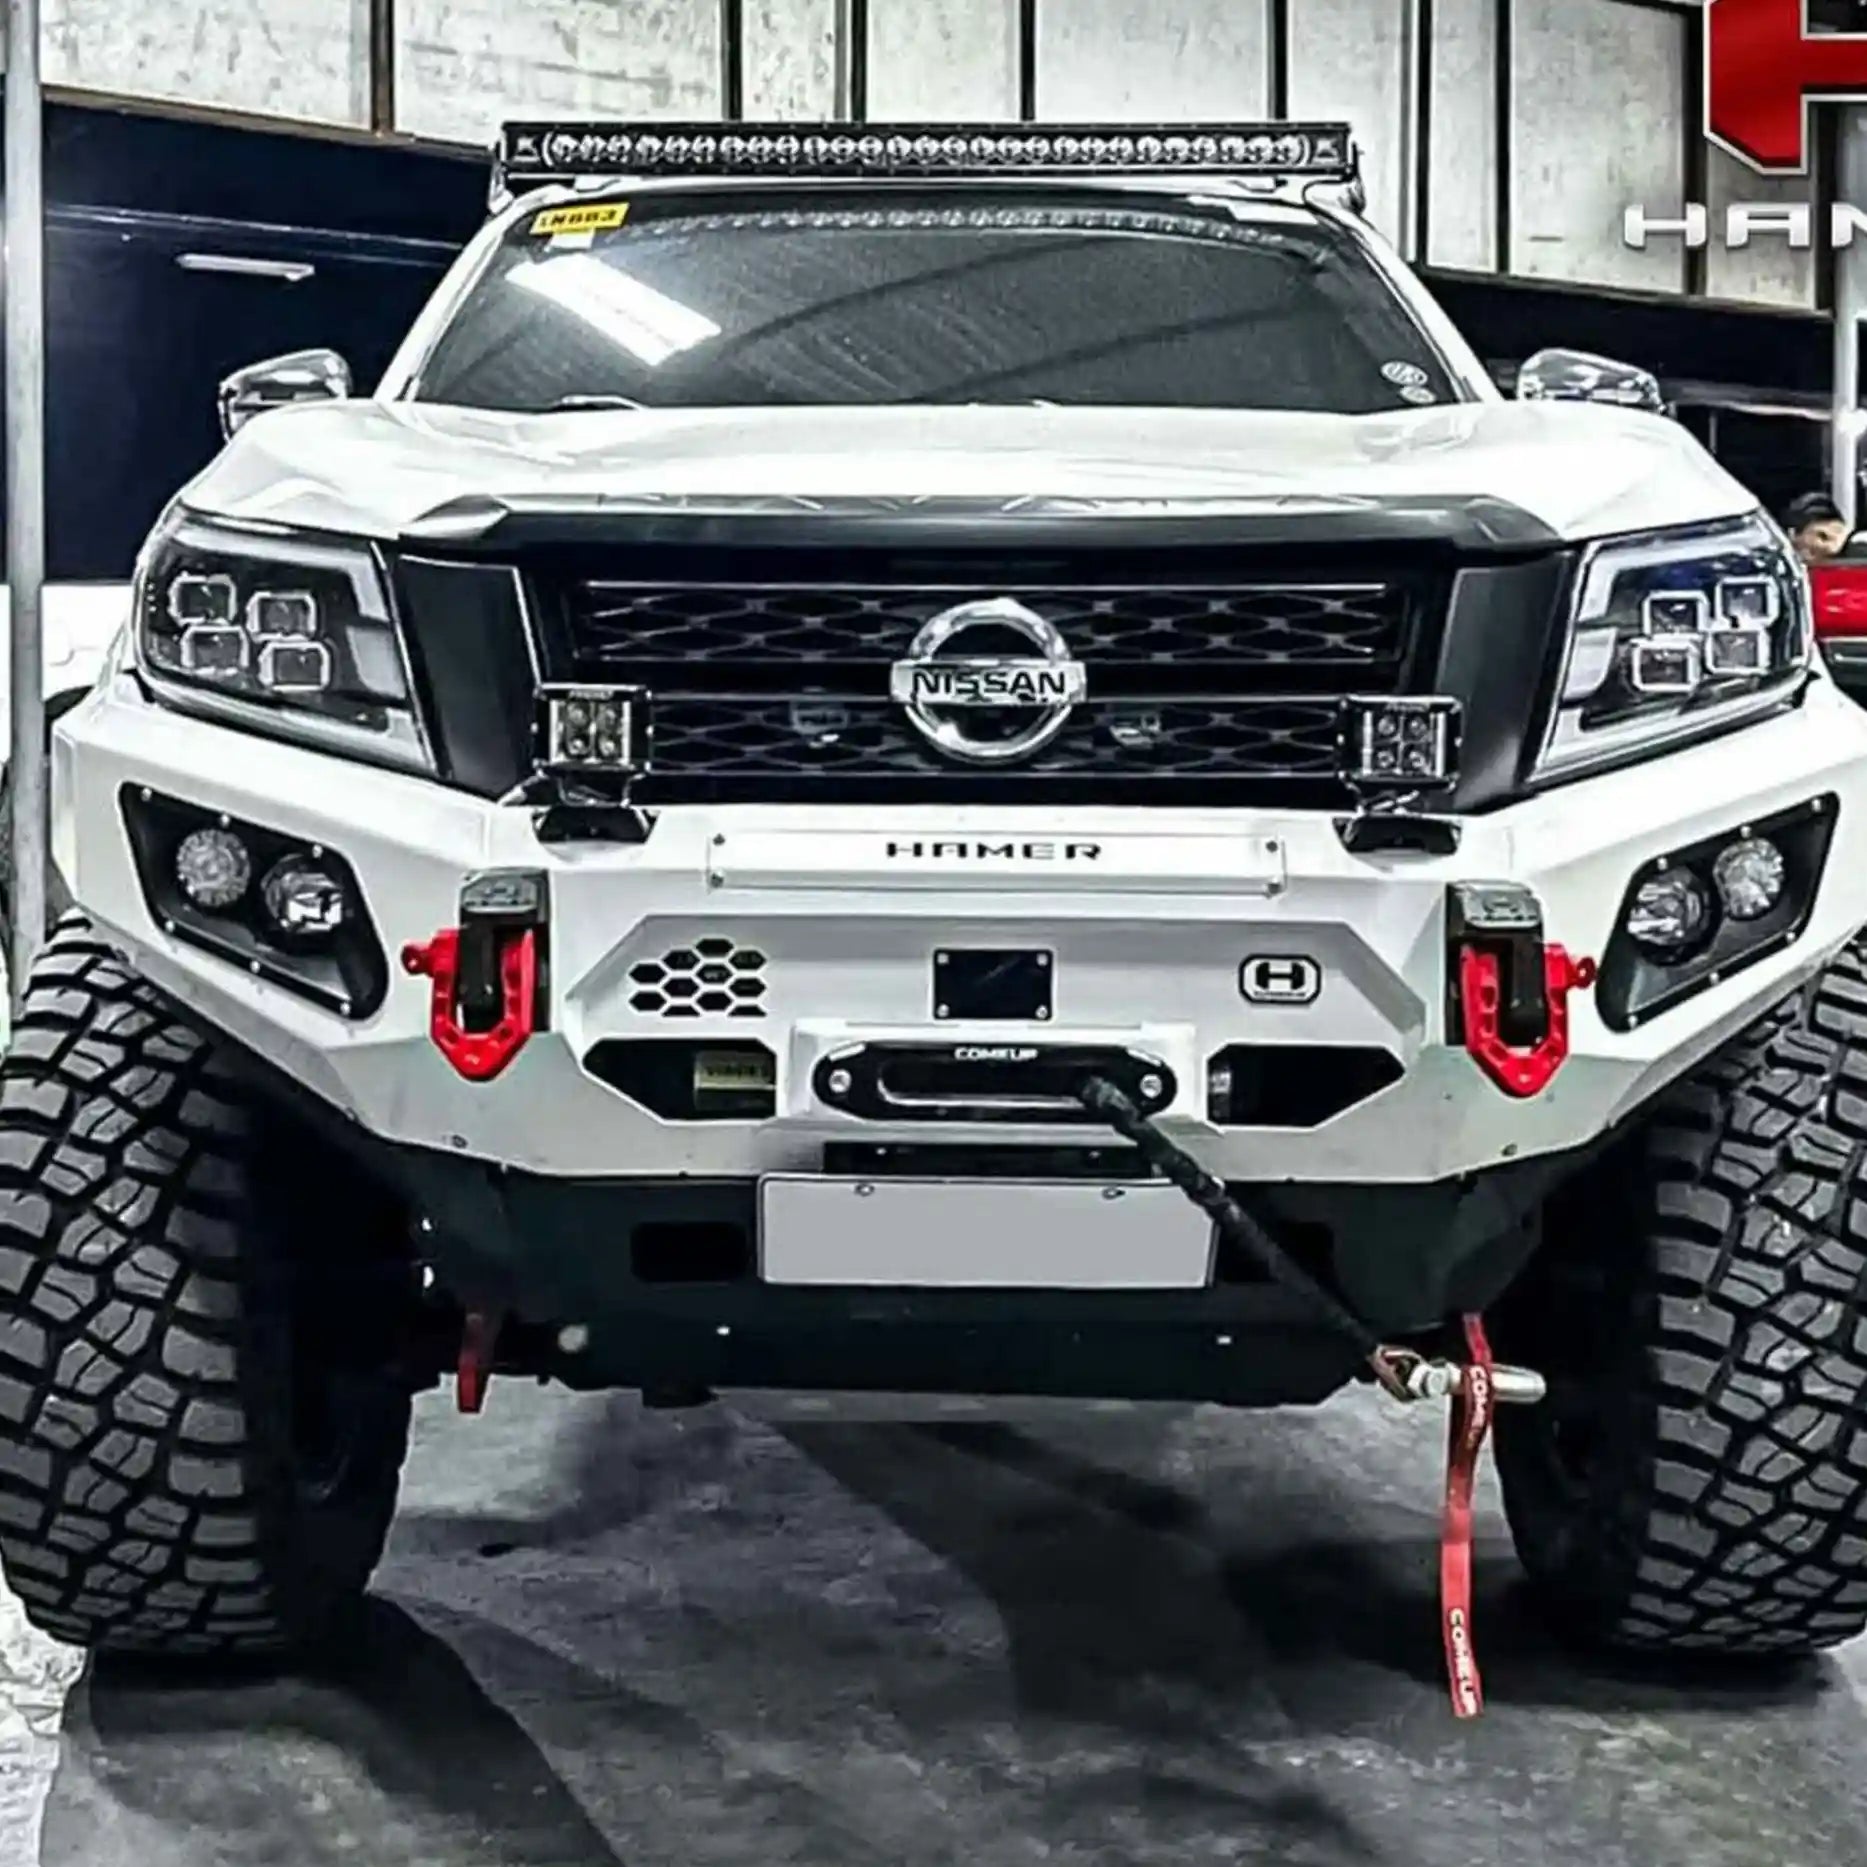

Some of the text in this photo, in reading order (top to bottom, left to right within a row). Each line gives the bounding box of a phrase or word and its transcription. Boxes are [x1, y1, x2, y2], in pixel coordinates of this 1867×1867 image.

[912, 670, 1066, 695] NISSAN
[887, 842, 1101, 860] HAMER
[954, 1047, 1039, 1061] COMEUP
